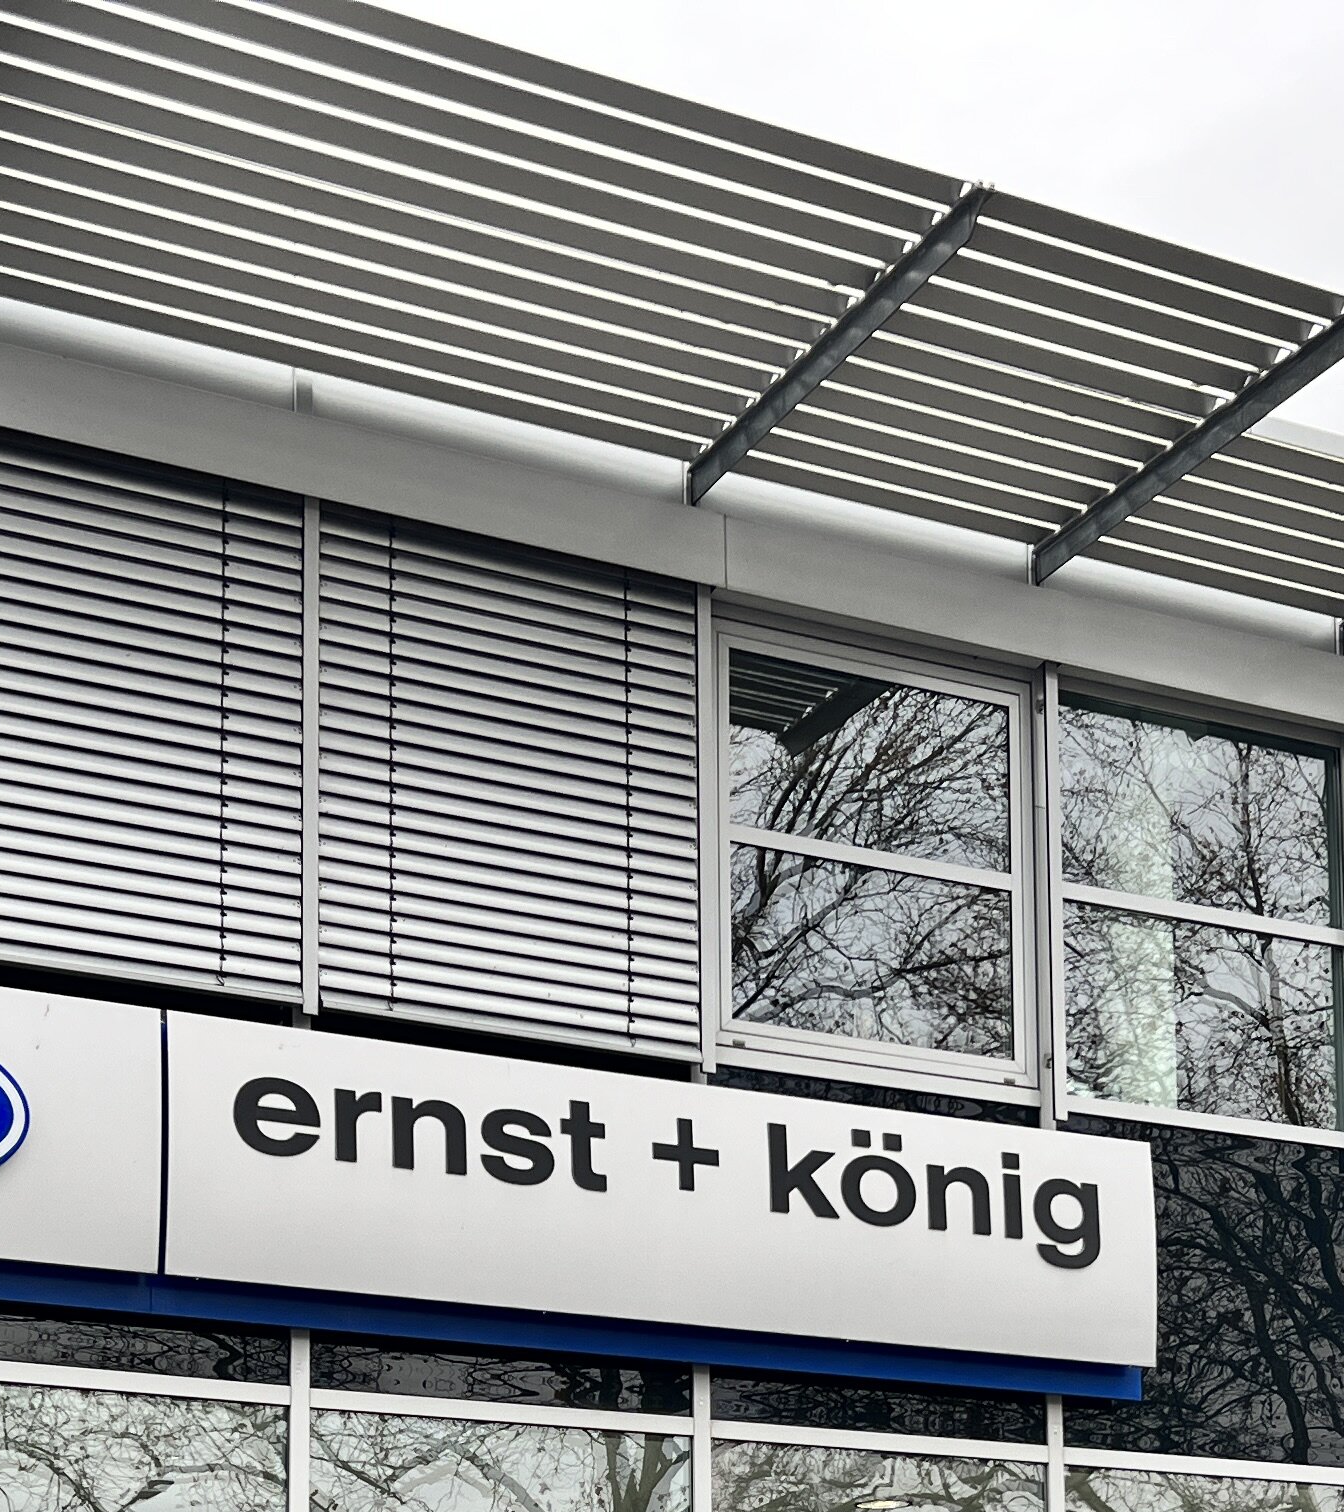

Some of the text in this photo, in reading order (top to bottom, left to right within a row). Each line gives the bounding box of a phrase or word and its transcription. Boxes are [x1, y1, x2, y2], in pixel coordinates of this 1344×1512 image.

[232, 1076, 1101, 1270] ernst + könig
